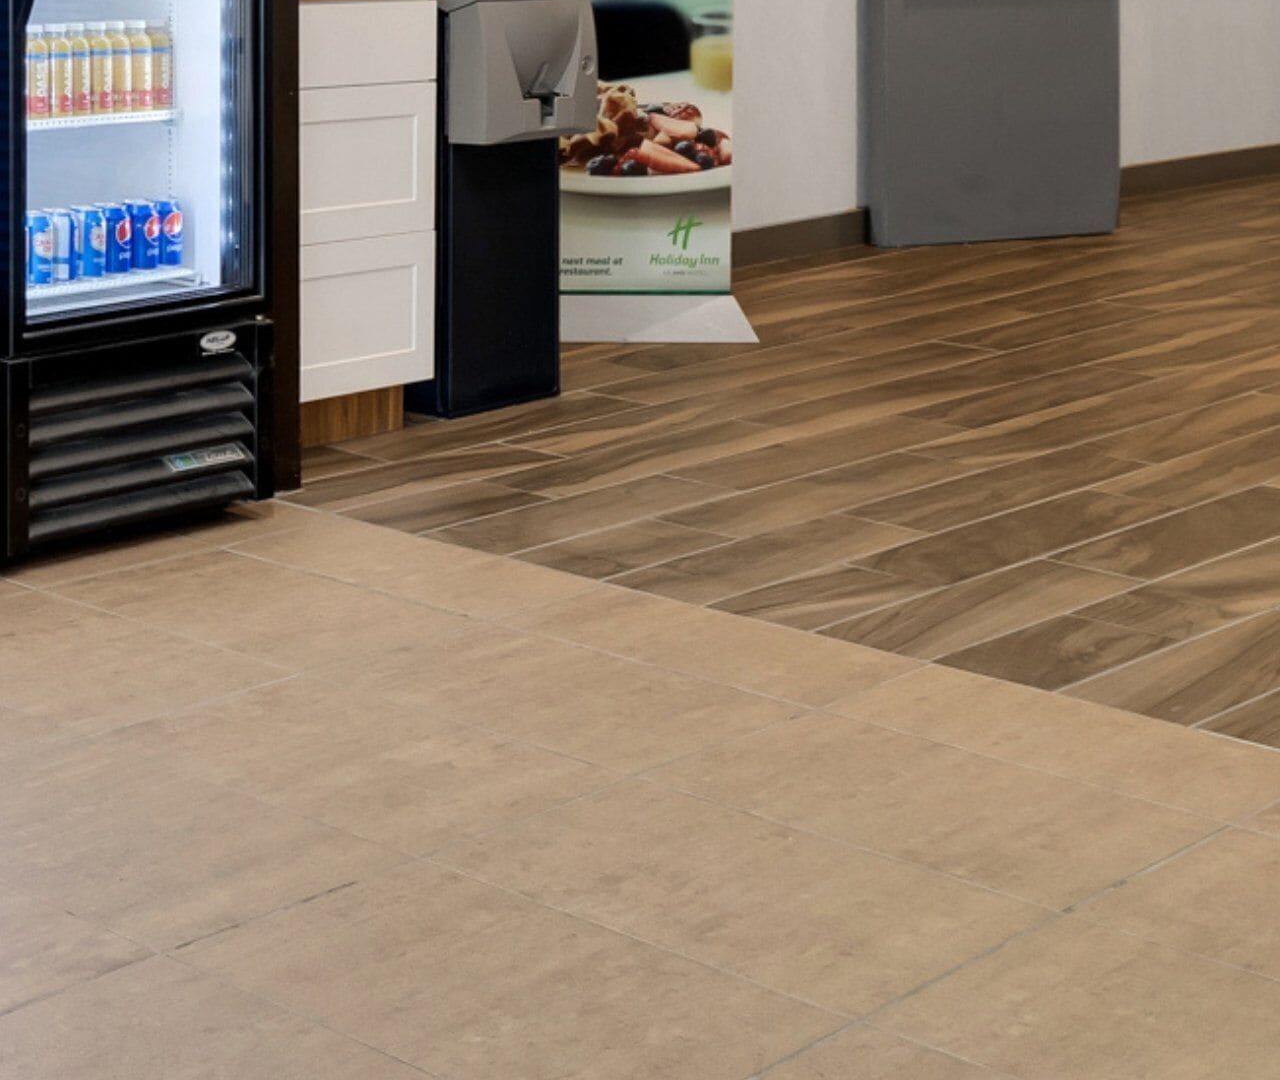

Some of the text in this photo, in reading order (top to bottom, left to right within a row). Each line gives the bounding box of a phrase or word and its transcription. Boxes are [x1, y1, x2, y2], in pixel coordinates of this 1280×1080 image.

[585, 256, 610, 265] meal
[613, 257, 623, 265] at
[649, 253, 720, 269] Holiday Inn
